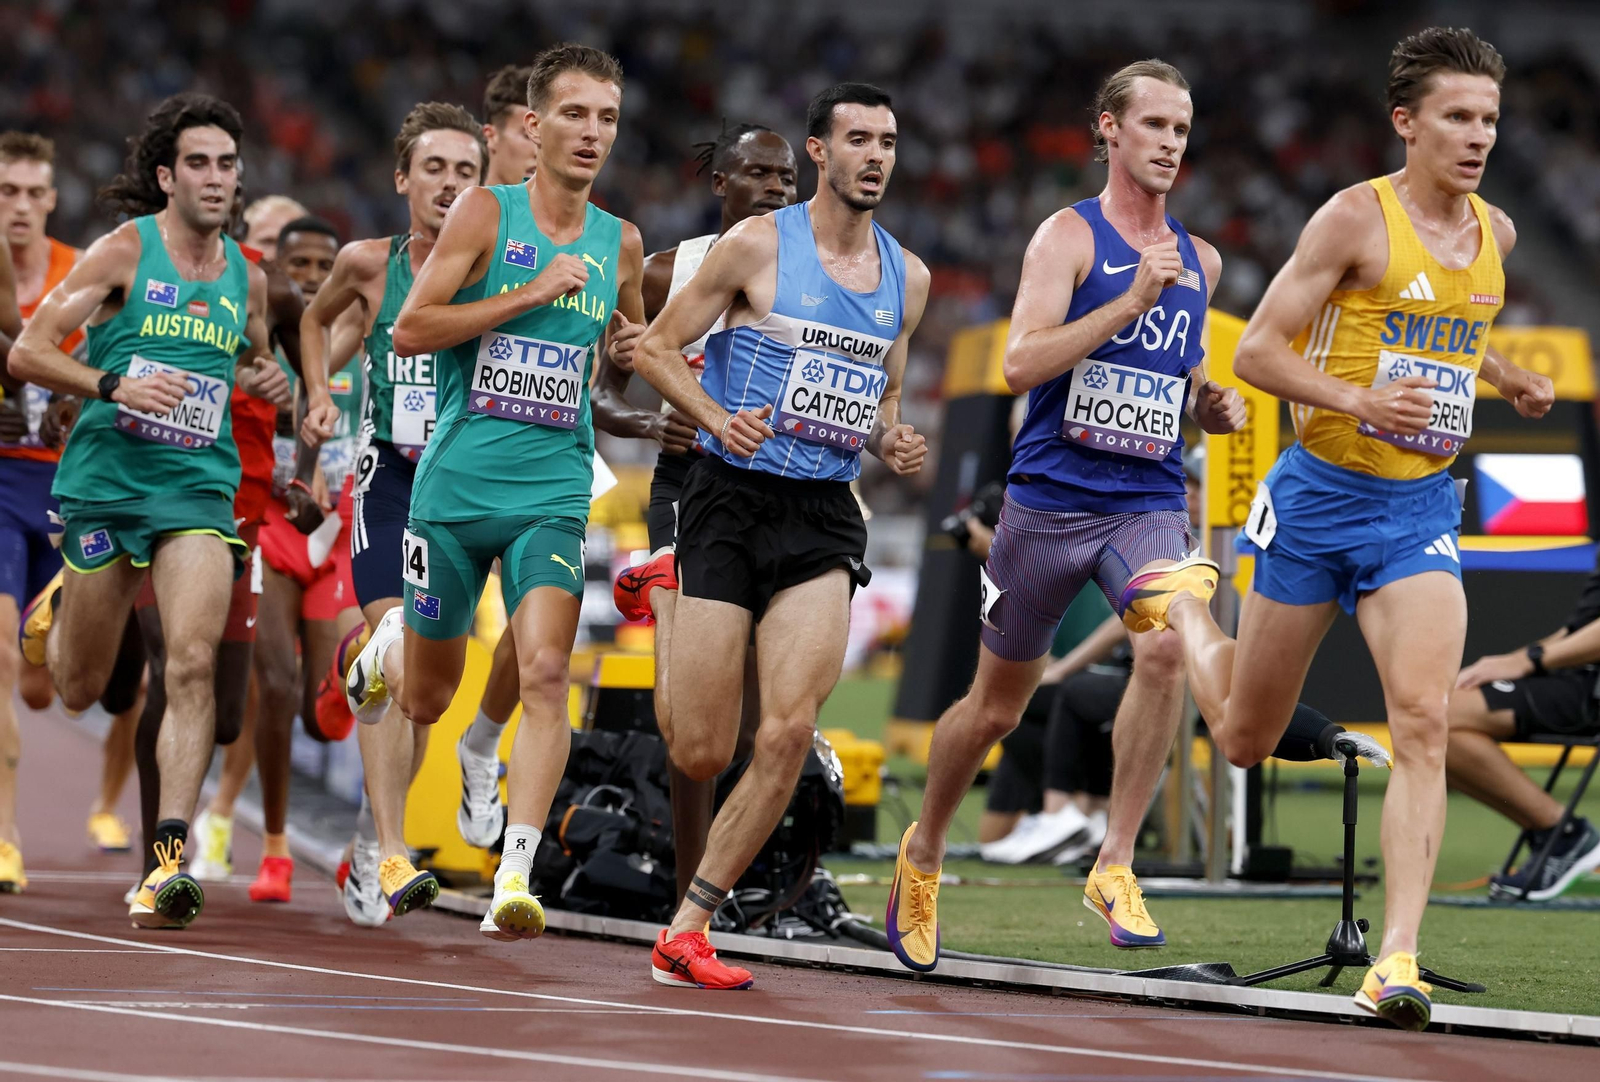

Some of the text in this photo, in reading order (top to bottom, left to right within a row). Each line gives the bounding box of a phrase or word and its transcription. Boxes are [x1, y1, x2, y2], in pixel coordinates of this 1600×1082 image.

[140, 314, 239, 356] AUSTRALIA
[802, 327, 884, 359] URUGUAY
[1380, 311, 1488, 355] SWEDE
[387, 351, 436, 384] IRE
[514, 339, 582, 373] TDK
[479, 365, 579, 405] ROBINSON
[827, 362, 884, 399] TDK
[1110, 368, 1178, 404] TDK
[1414, 361, 1471, 398] TDK
[1073, 395, 1174, 438] HOCKER
[404, 538, 426, 580] 14
